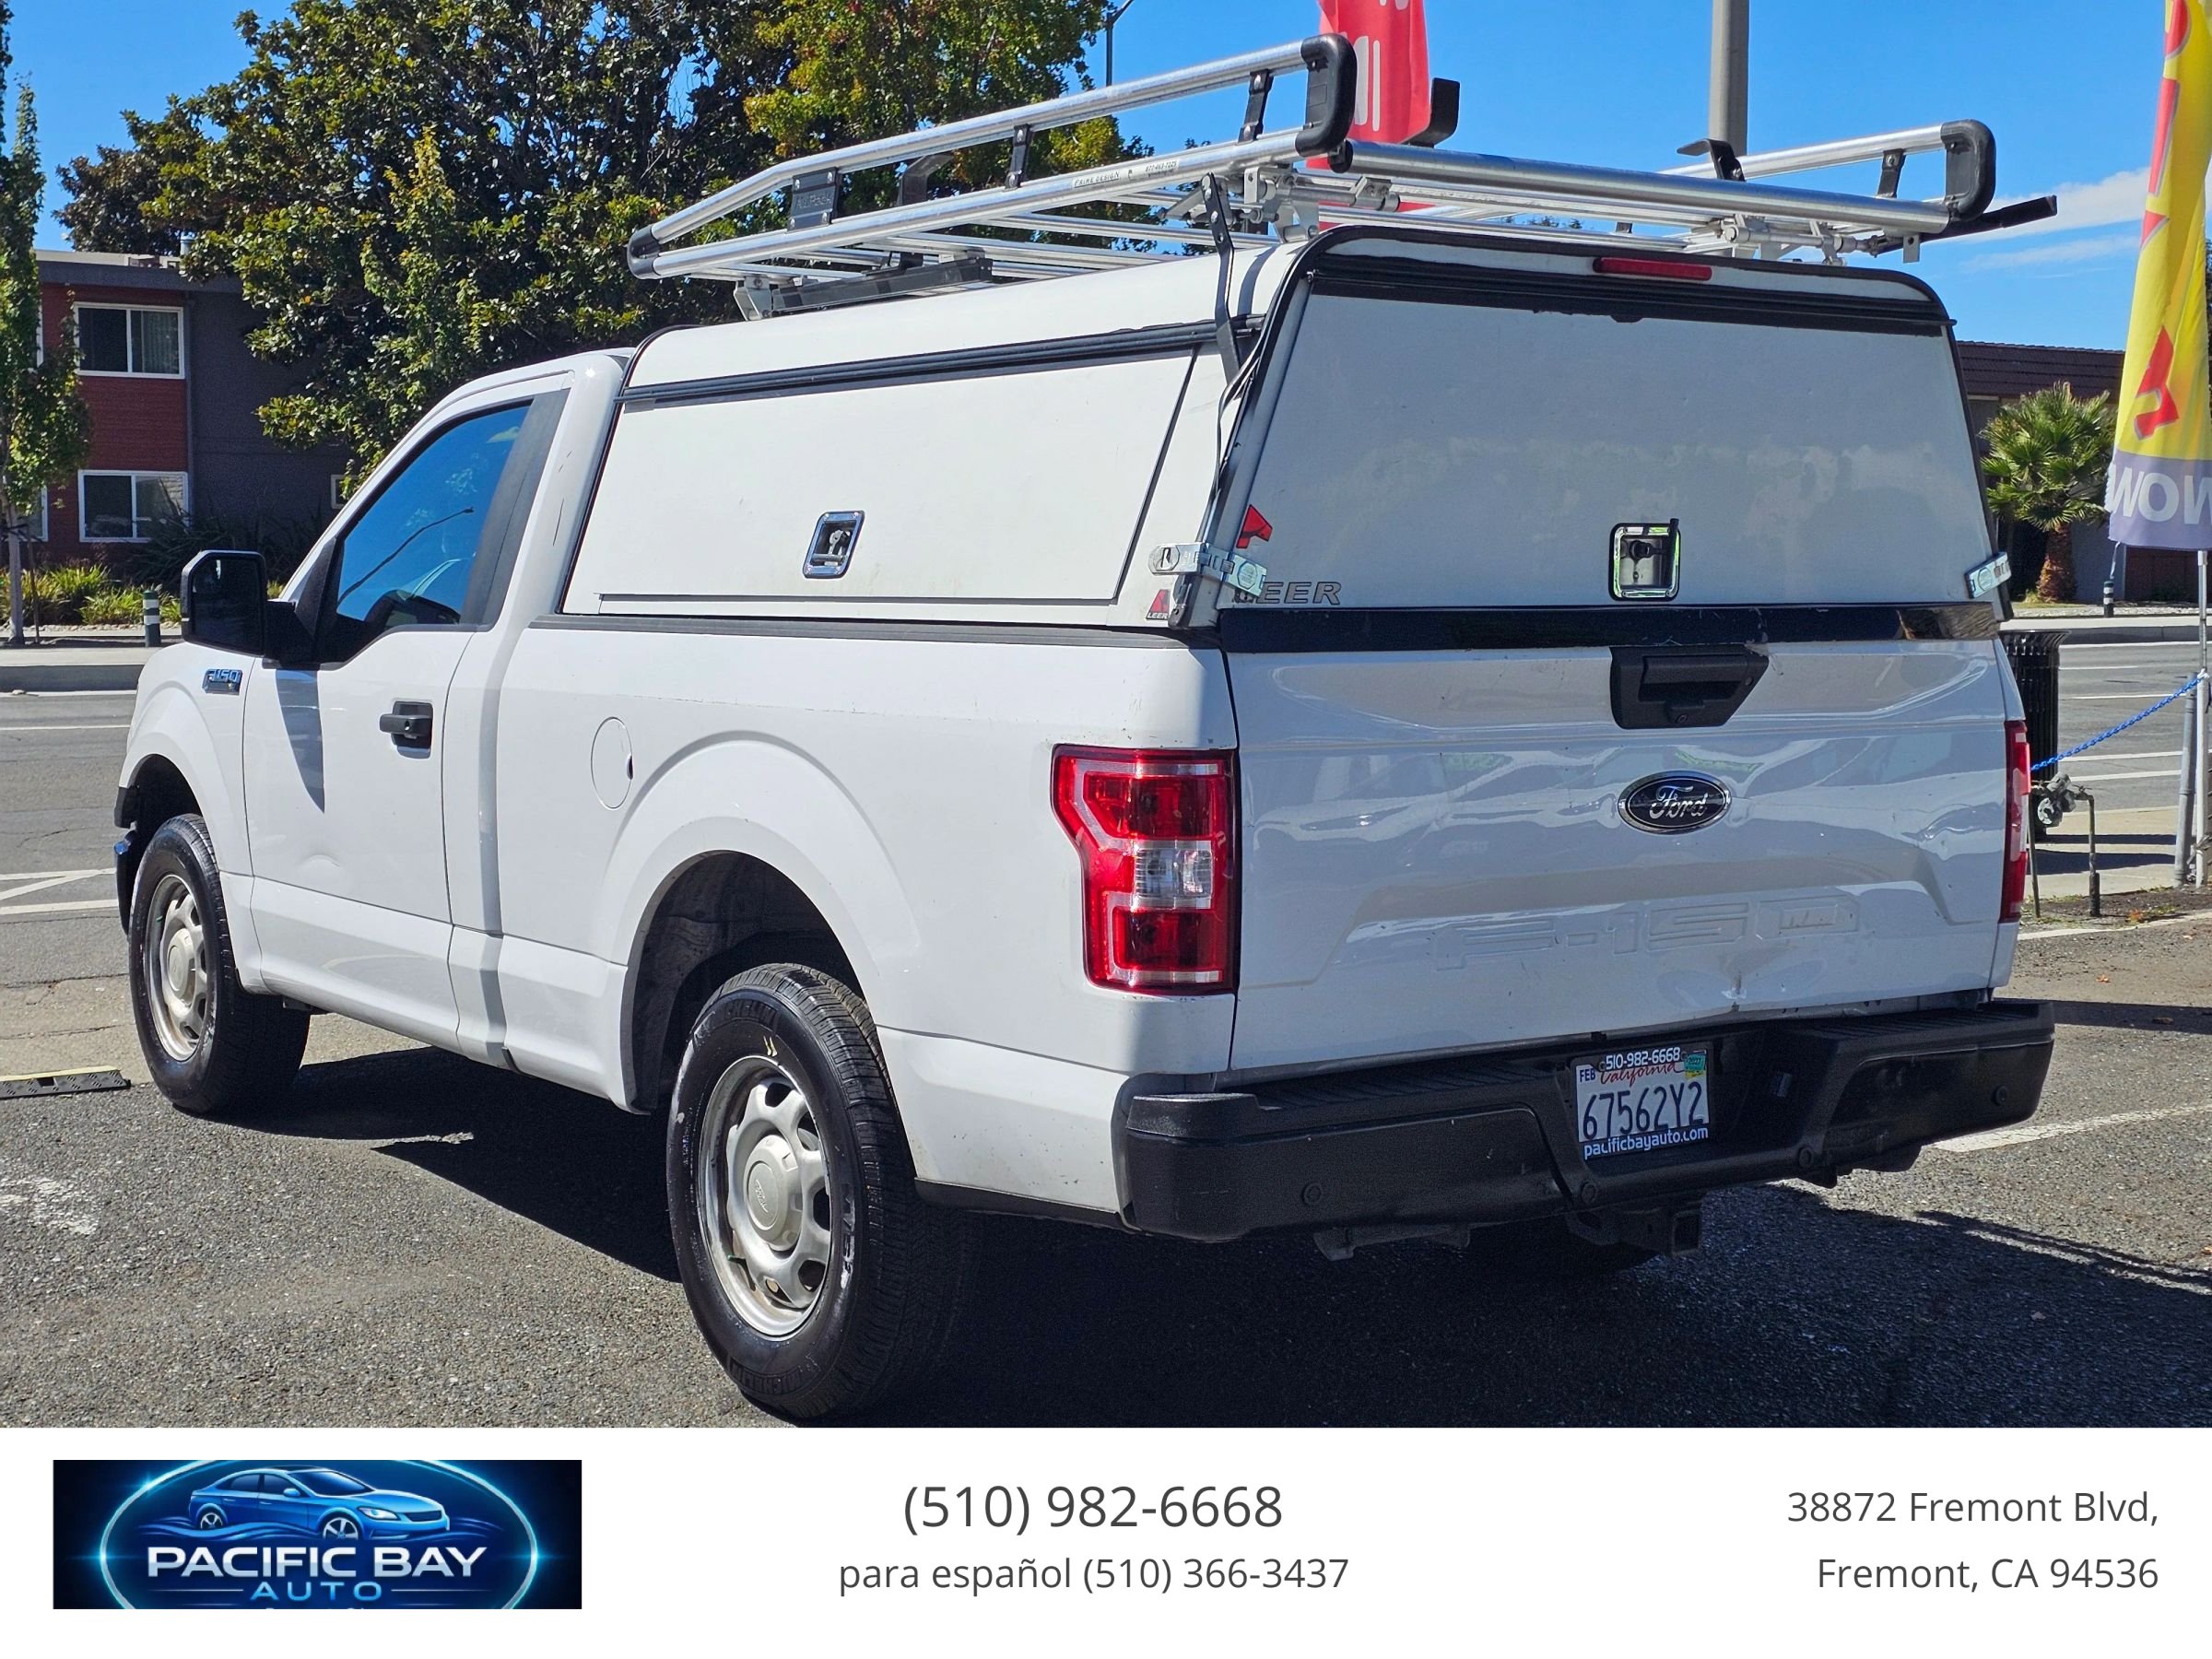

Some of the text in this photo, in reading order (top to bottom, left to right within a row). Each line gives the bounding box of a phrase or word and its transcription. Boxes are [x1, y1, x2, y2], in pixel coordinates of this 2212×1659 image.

[1075, 171, 1120, 186] PRIME DESIGN
[2104, 465, 2212, 524] WOW
[1147, 612, 1169, 620] LEER
[1649, 785, 1709, 819] Ford
[1435, 894, 1859, 971] F-150
[1606, 1046, 1681, 1072] 510-982-6668
[1579, 1067, 1596, 1083] FEB
[1600, 1061, 1686, 1088] California
[1583, 1081, 1704, 1140] 67562Y2
[1583, 1127, 1709, 1160] pacificbayauto.com
